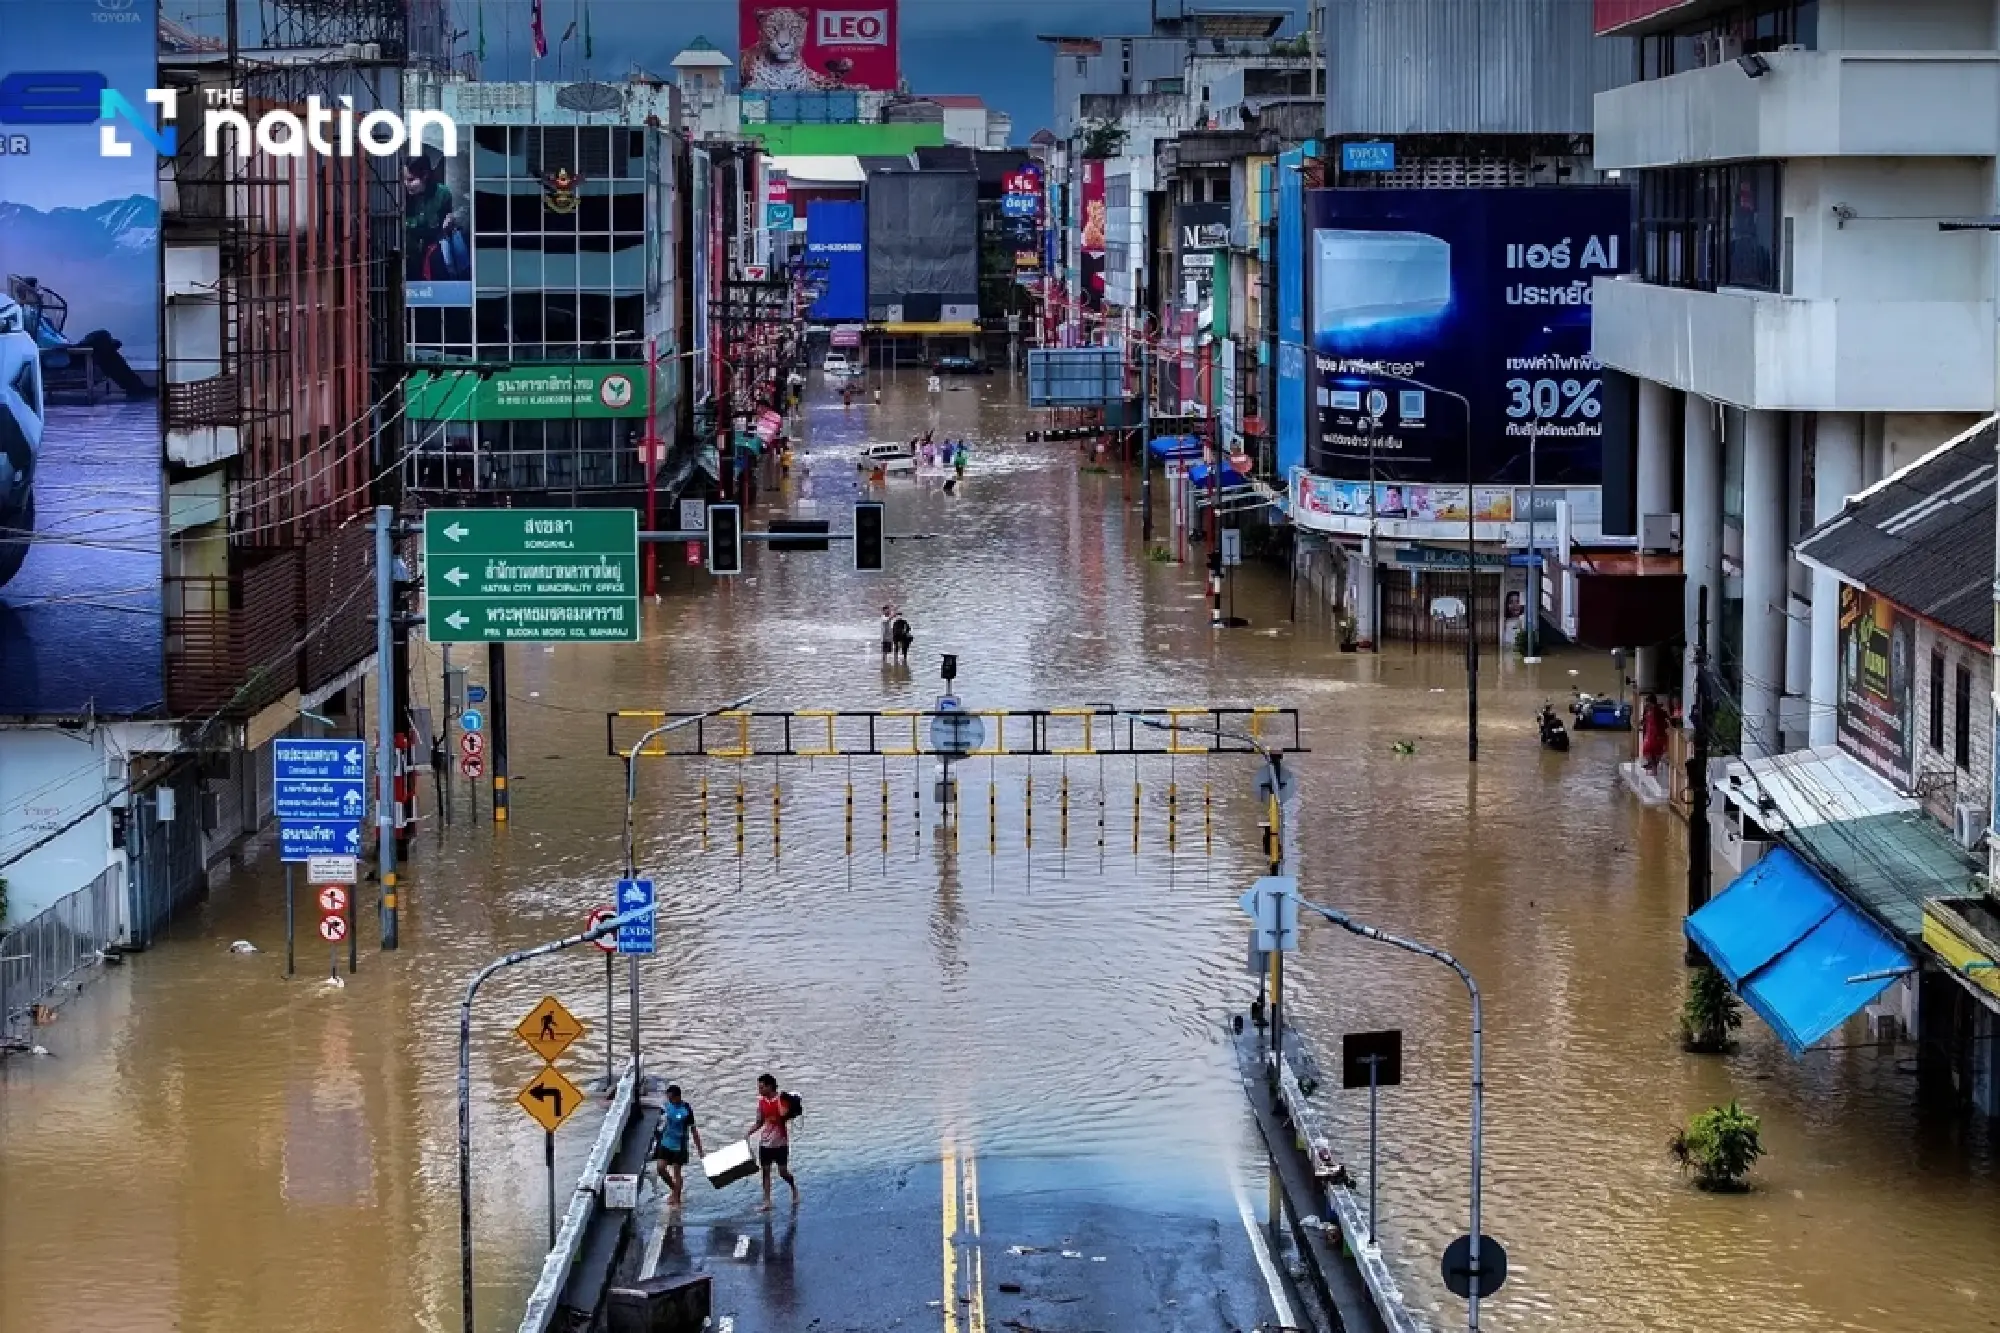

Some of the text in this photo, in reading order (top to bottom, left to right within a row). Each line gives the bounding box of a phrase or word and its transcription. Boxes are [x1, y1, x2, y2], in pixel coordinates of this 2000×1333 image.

[91, 12, 141, 23] TOYOTA
[823, 16, 881, 38] LEO
[1506, 234, 1619, 268] แอร์ AI
[1505, 378, 1602, 417] 30%
[524, 518, 573, 534] สงขลา
[512, 583, 532, 592] CITY
[536, 583, 593, 592] MUNICIPALITY
[595, 583, 625, 592] OFFICE
[506, 628, 540, 637] BUDDHA
